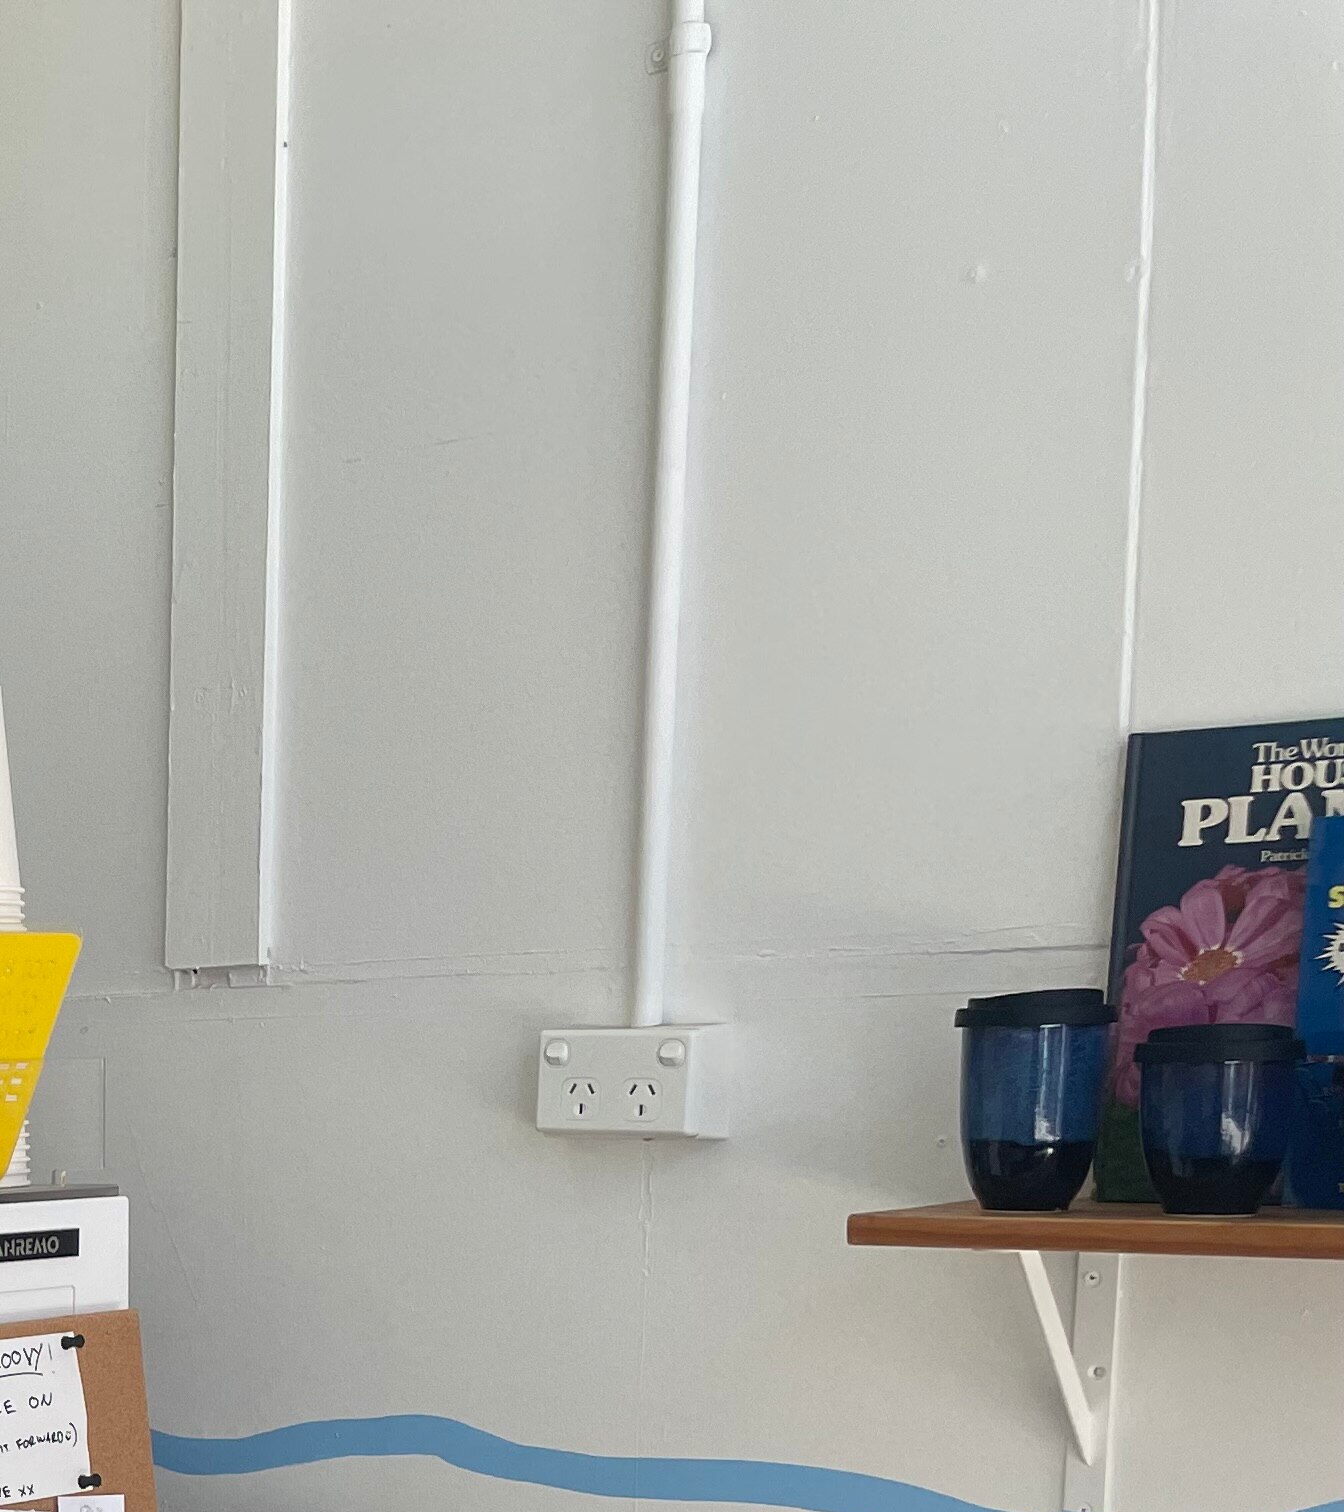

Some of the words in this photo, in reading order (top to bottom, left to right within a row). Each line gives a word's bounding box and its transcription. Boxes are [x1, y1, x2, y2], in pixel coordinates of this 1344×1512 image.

[1253, 741, 1298, 763] The
[1250, 759, 1344, 794] HOU
[28, 1393, 53, 1409] ON
